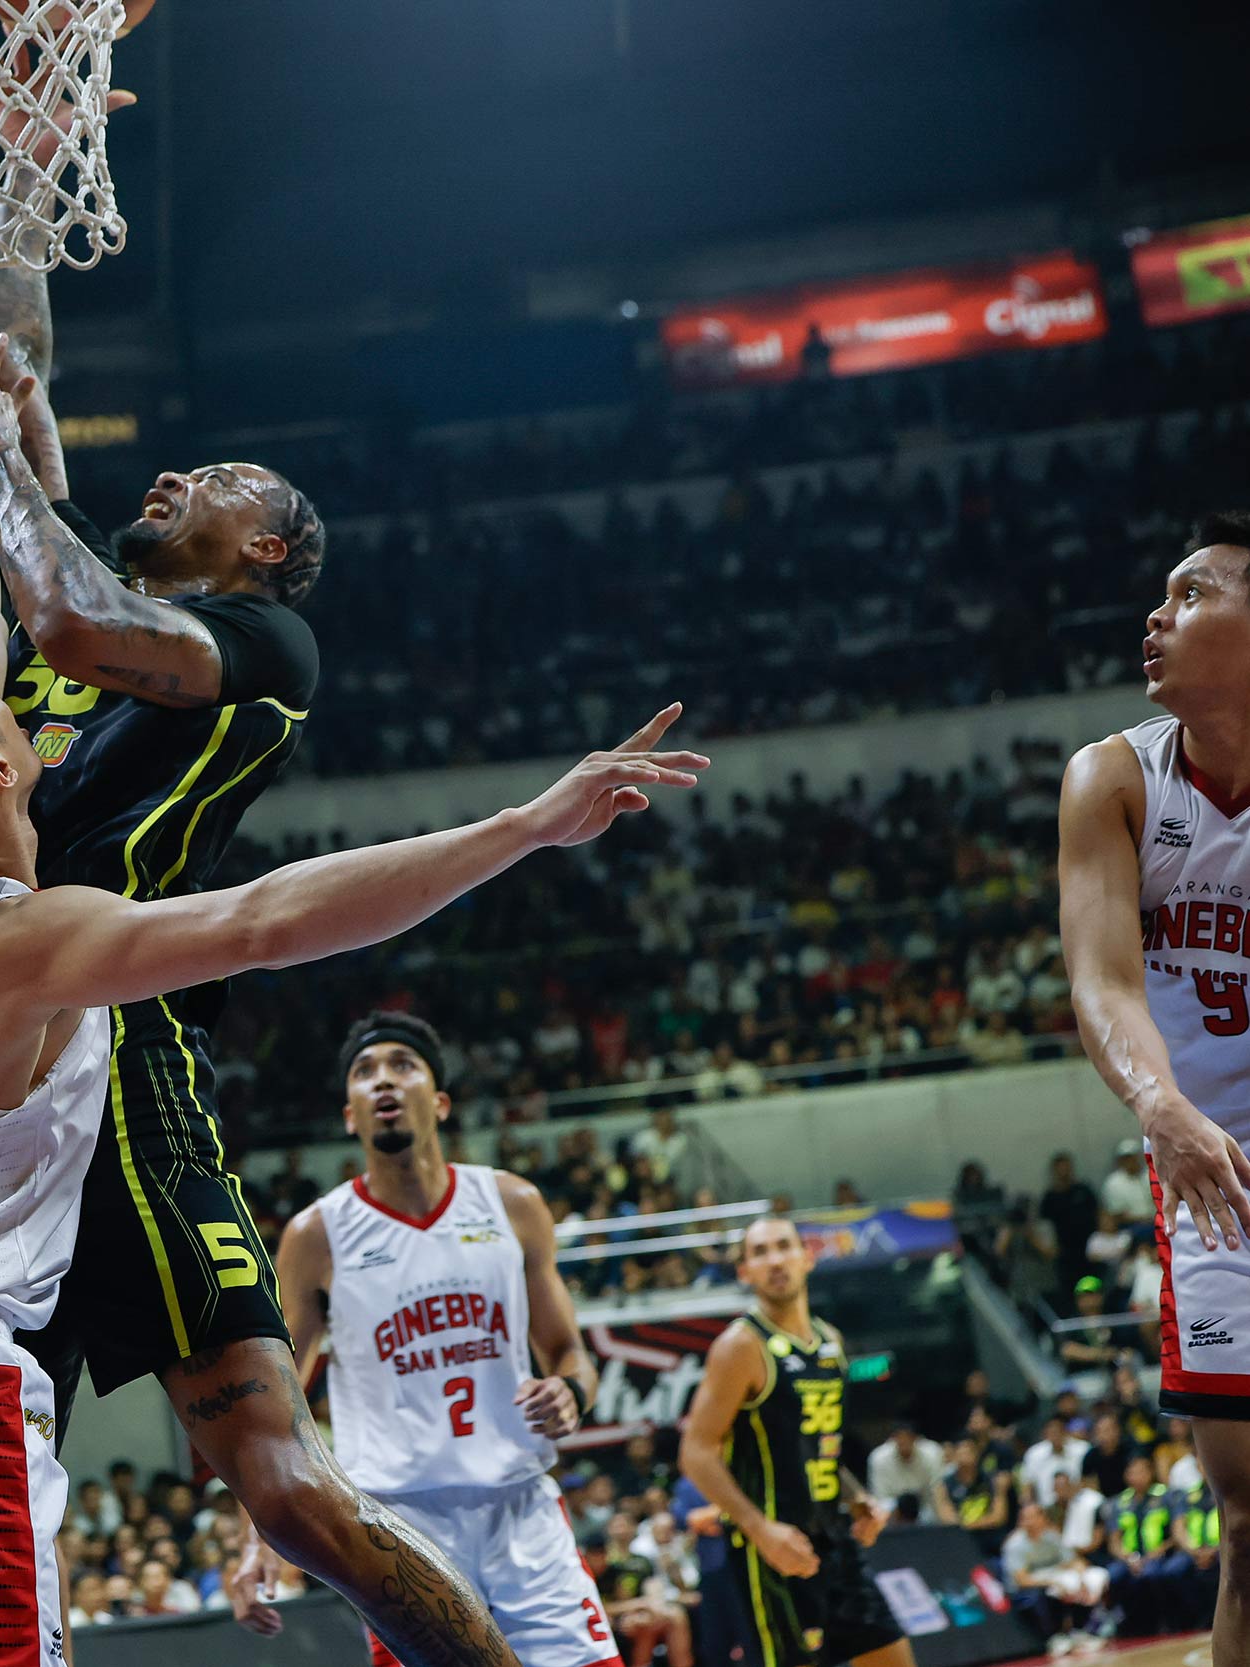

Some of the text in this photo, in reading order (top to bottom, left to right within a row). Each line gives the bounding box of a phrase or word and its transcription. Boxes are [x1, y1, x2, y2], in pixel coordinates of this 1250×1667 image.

[33, 729, 82, 760] TNT
[1170, 881, 1250, 900] ARANG
[196, 1221, 259, 1289] 5
[373, 1292, 511, 1363] GINEBRA
[1188, 1337, 1234, 1348] BALANCE
[1192, 1331, 1228, 1340] WORLD
[393, 1349, 437, 1377] SAN
[443, 1375, 476, 1438] 2
[804, 1458, 840, 1502] 15
[581, 1597, 607, 1642] 2
